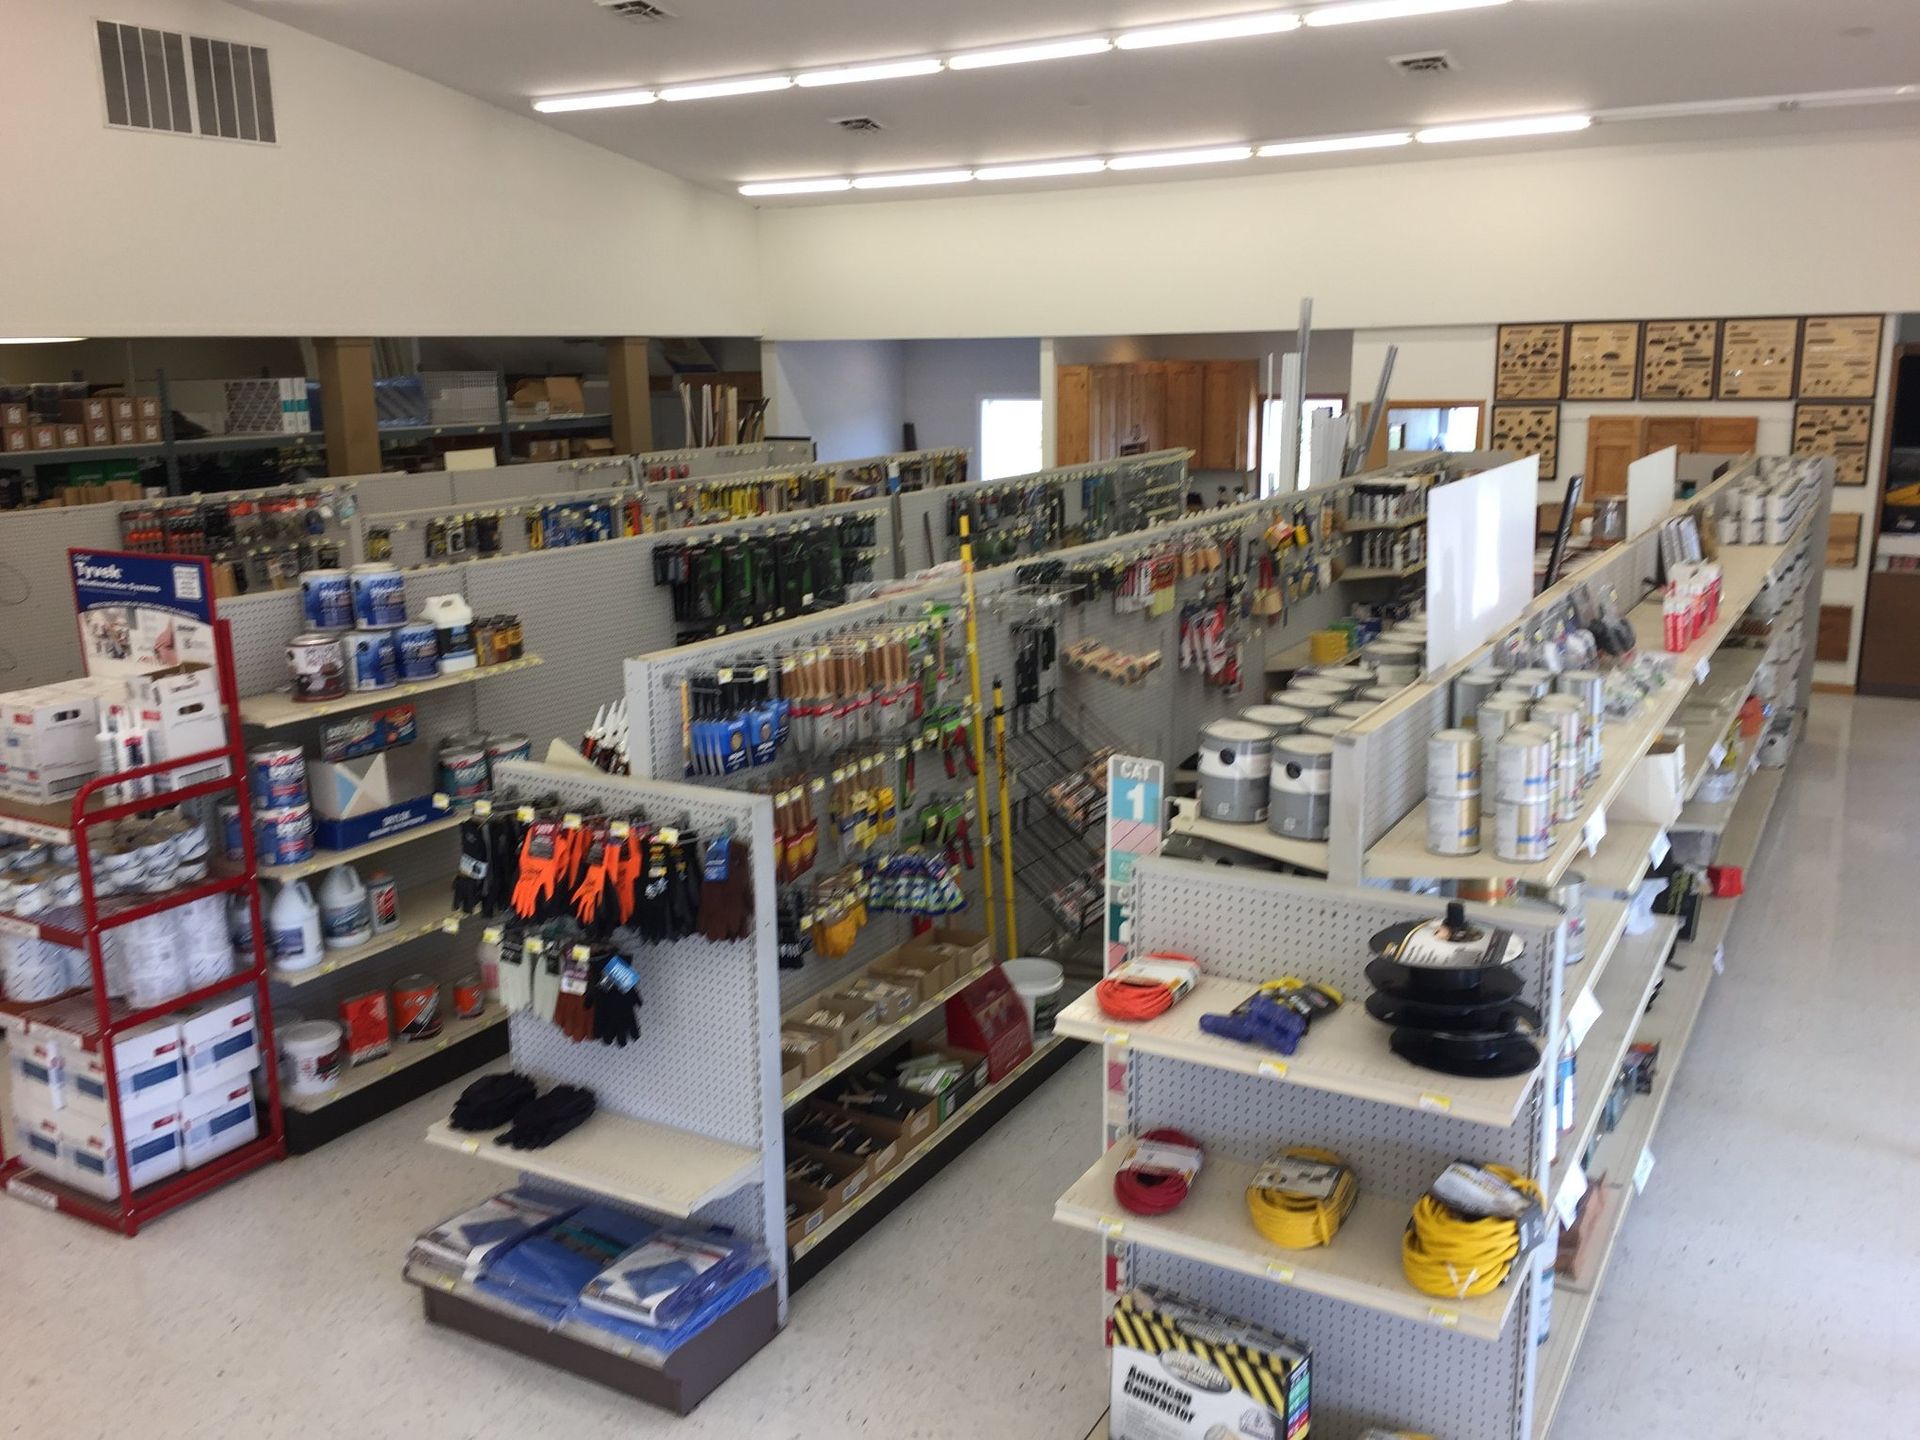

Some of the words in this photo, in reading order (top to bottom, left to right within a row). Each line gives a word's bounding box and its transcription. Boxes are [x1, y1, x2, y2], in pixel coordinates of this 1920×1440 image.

[74, 561, 123, 580] Tyvek
[1119, 761, 1152, 781] CAT
[1126, 782, 1146, 821] 1
[1123, 1379, 1197, 1424] Contractor
[1127, 1363, 1193, 1406] American
